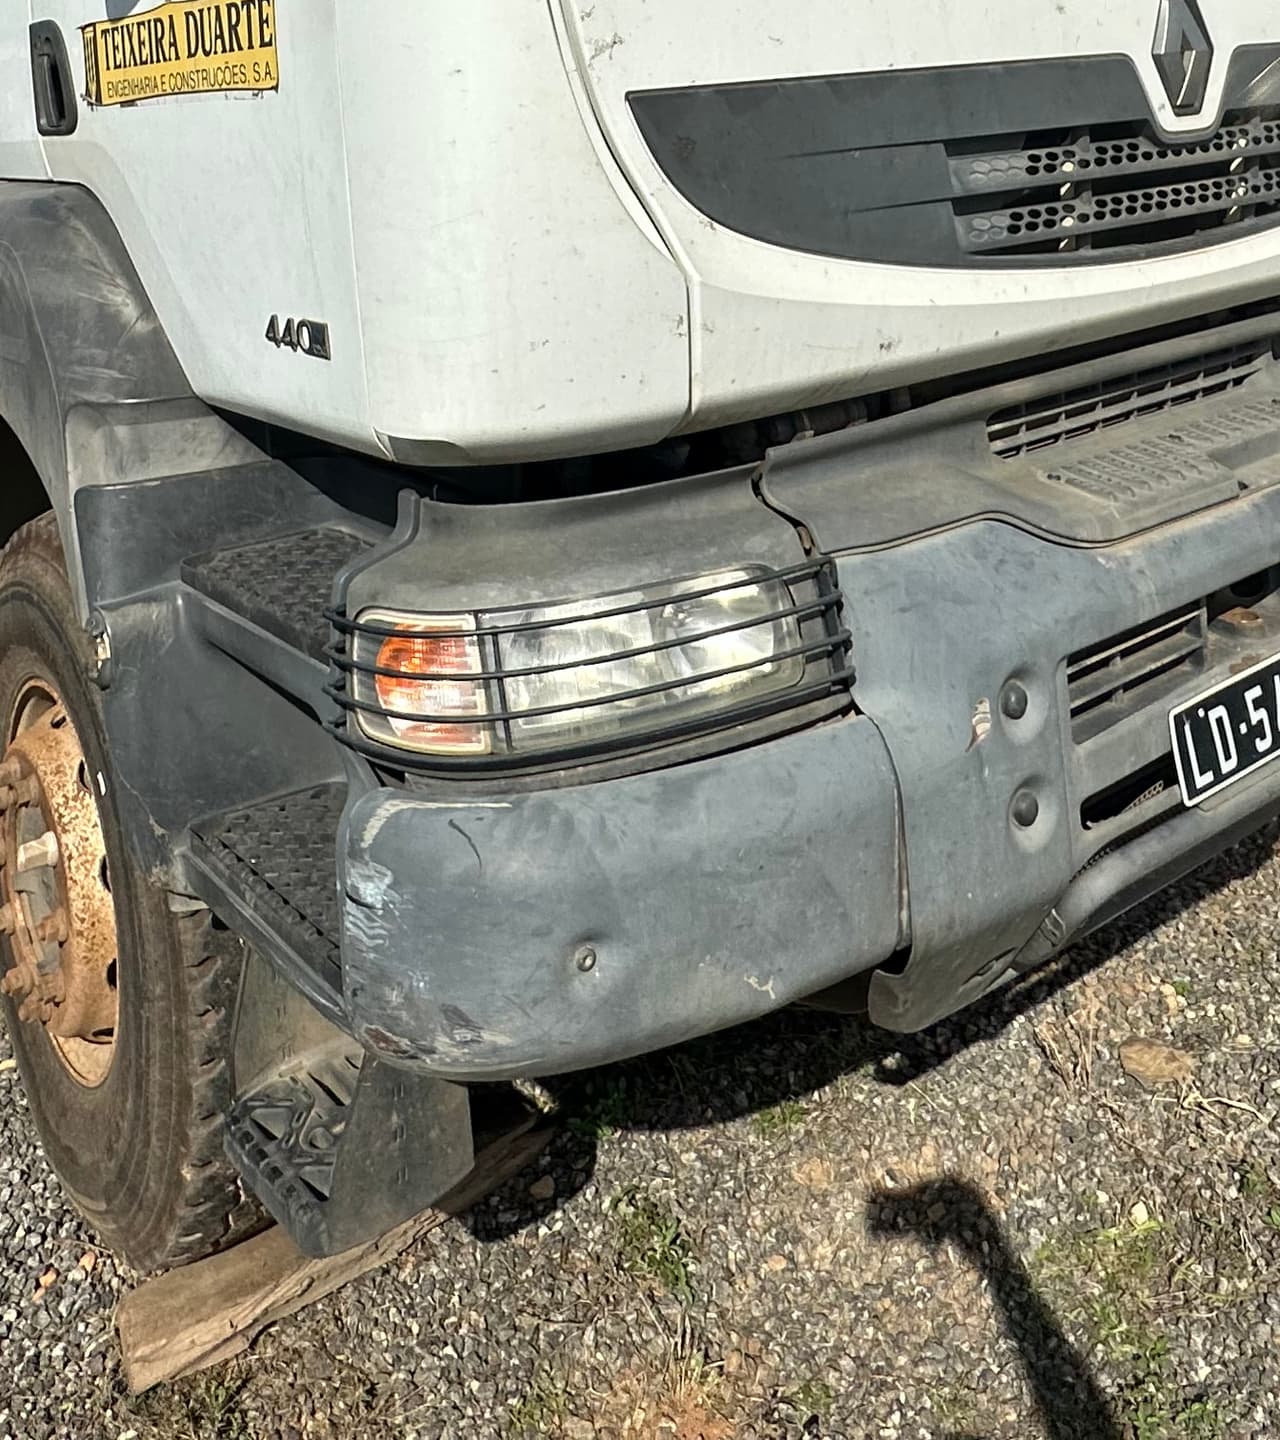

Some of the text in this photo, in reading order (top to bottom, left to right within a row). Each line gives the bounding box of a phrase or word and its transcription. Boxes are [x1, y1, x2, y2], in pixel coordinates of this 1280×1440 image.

[101, 14, 180, 71] TEIXEIRA
[107, 77, 160, 99] ENGENHARIA
[161, 74, 167, 92] E
[265, 314, 313, 356] 440
